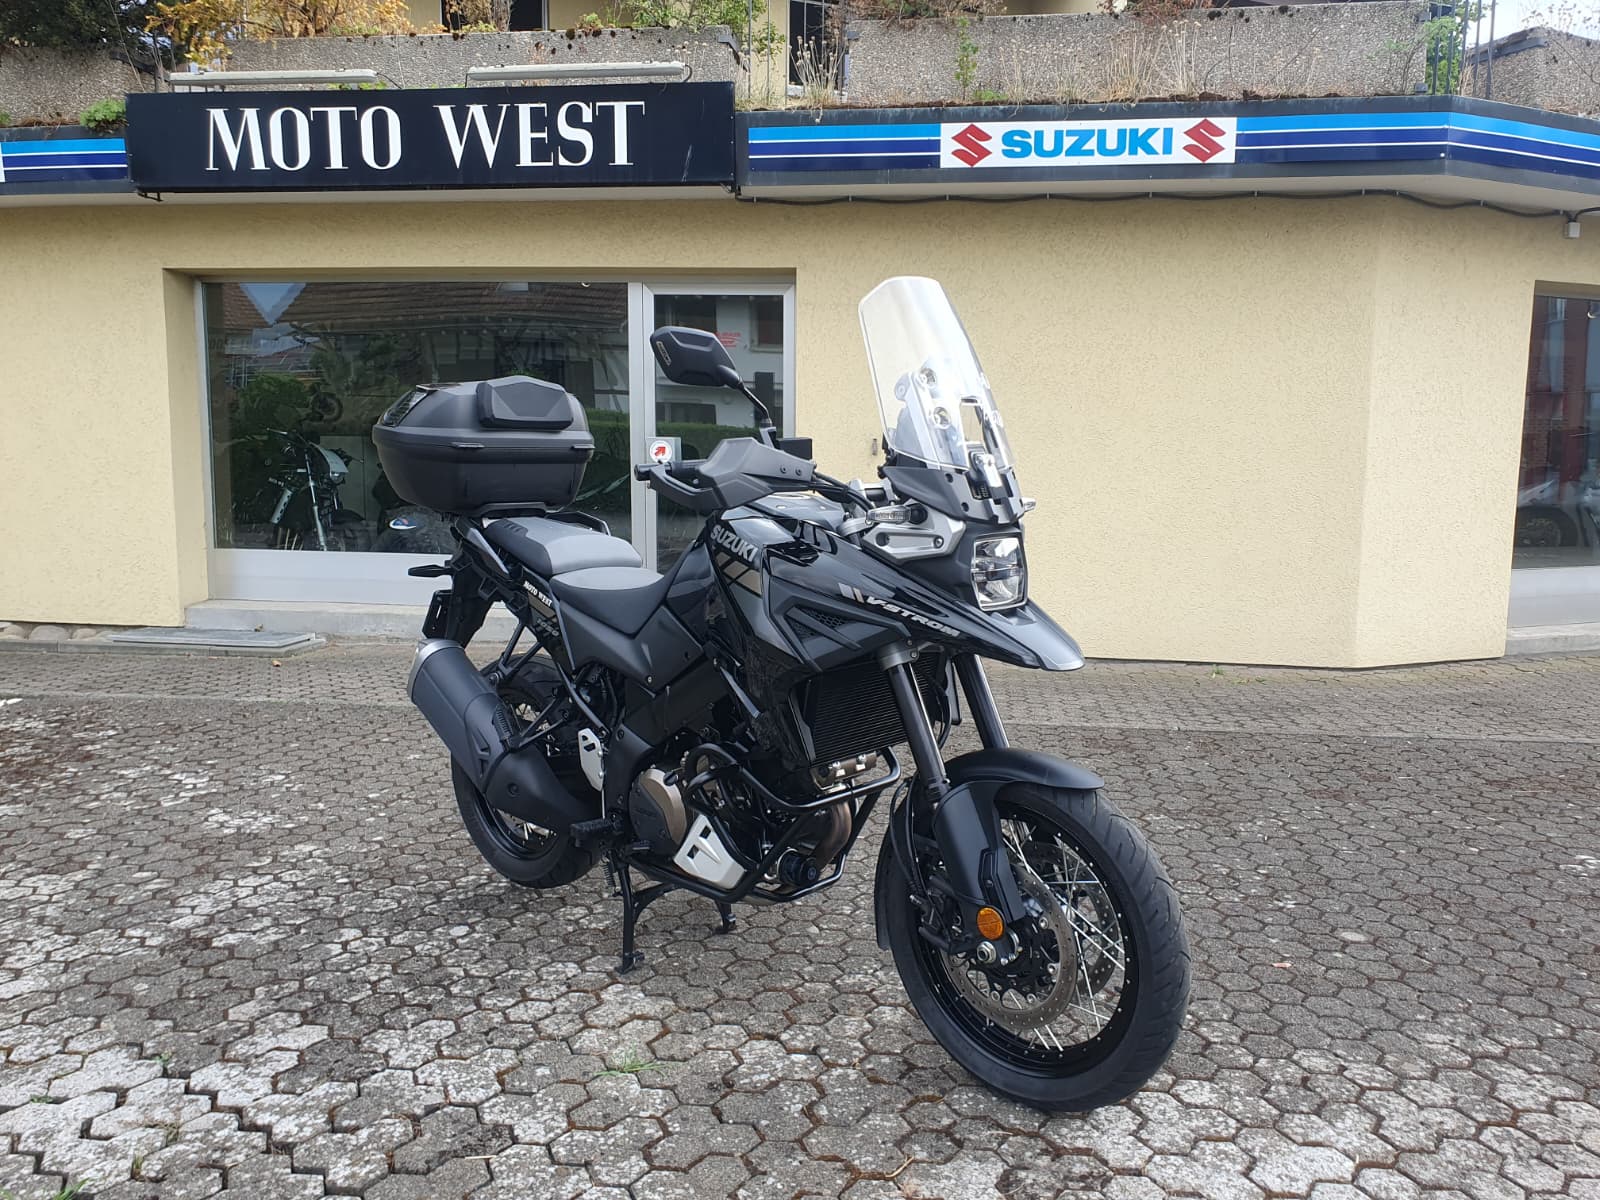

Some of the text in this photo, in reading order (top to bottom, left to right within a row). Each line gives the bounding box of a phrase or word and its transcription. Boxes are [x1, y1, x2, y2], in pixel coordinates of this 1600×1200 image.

[205, 101, 646, 172] MOTO WEST
[1001, 127, 1174, 159] SUZUKI
[710, 524, 759, 562] SUZUKI
[523, 580, 538, 596] MOTO
[866, 596, 960, 637] V-STROM
